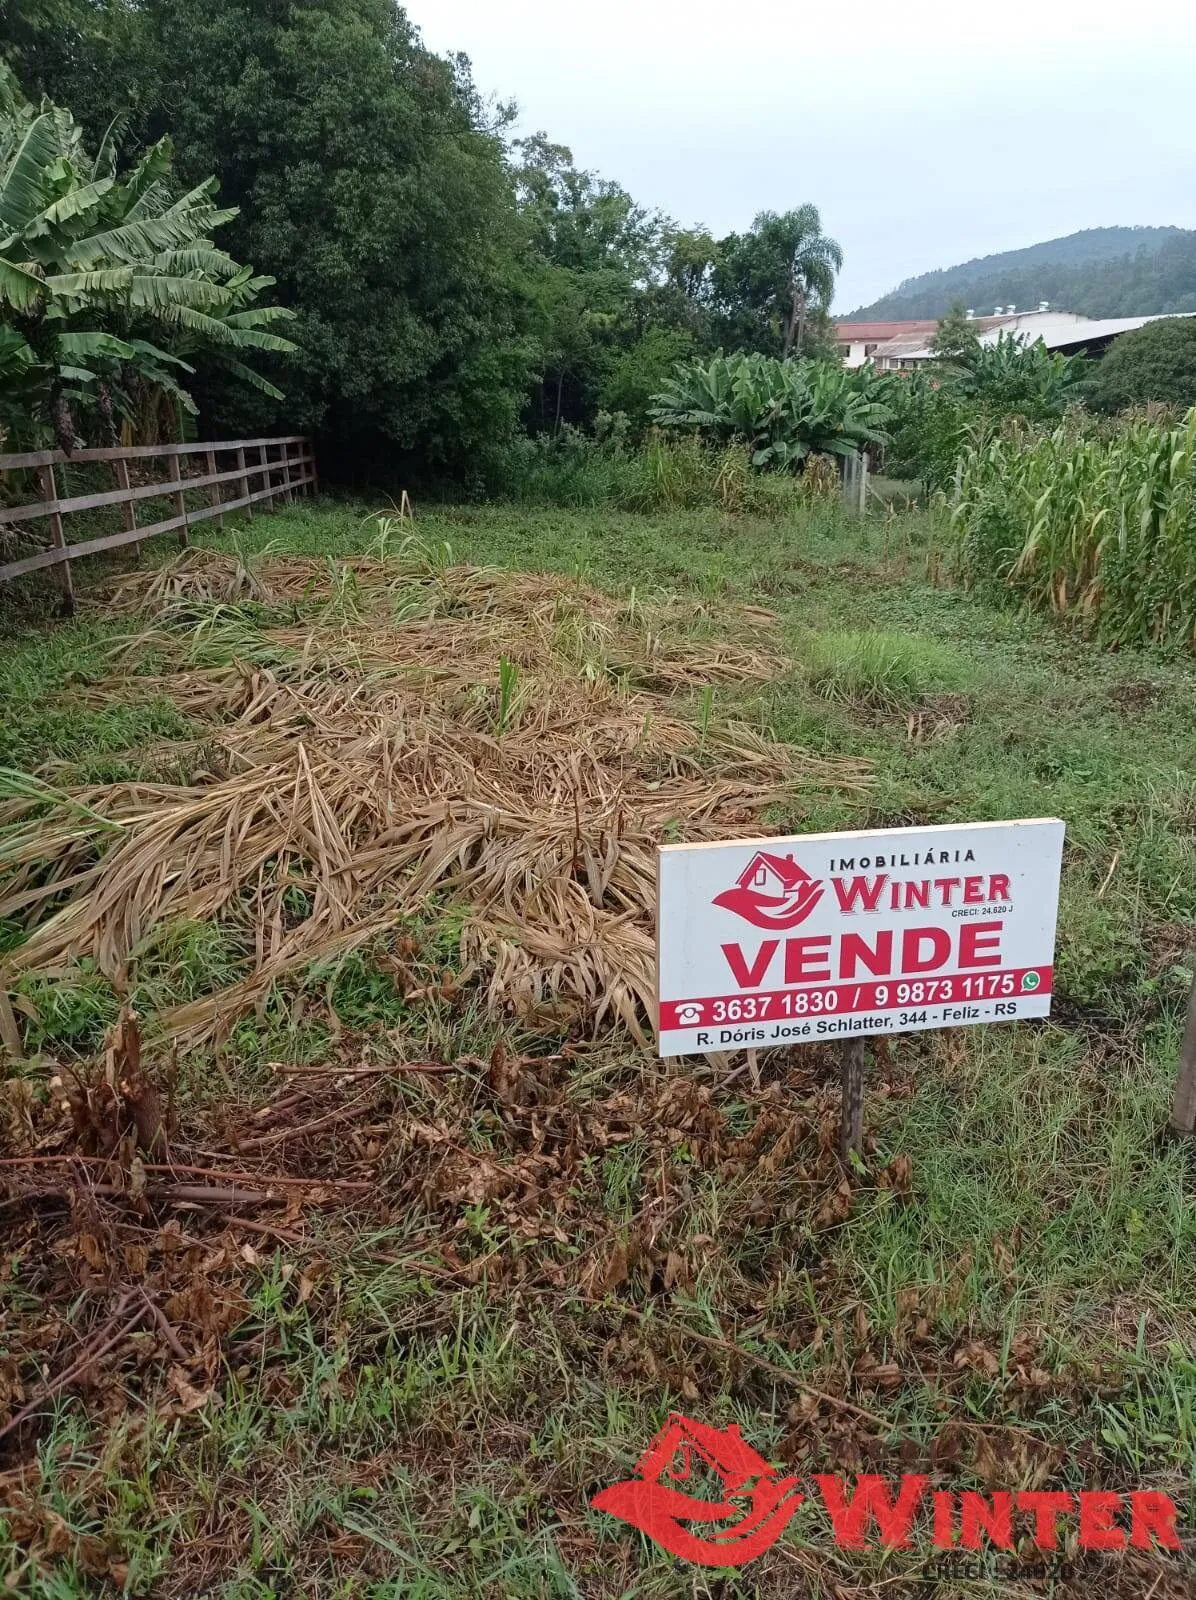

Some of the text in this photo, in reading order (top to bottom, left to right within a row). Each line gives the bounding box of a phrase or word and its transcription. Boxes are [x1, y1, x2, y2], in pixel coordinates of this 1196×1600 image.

[830, 848, 976, 871] IMOBILIÁRIA
[829, 873, 1012, 914] WINTER
[951, 905, 1013, 918] CRECI: 24.620 J
[720, 921, 1003, 988] VENDE
[712, 973, 1015, 1022] 3637 1830 / 9 9873 1175
[697, 1032, 714, 1045] R.
[720, 1027, 765, 1043] Dóris
[771, 1022, 811, 1039] José
[816, 1016, 893, 1034] Schlatter,
[899, 1012, 927, 1025] 344
[943, 1007, 979, 1021] Feliz
[995, 1002, 1017, 1015] RS
